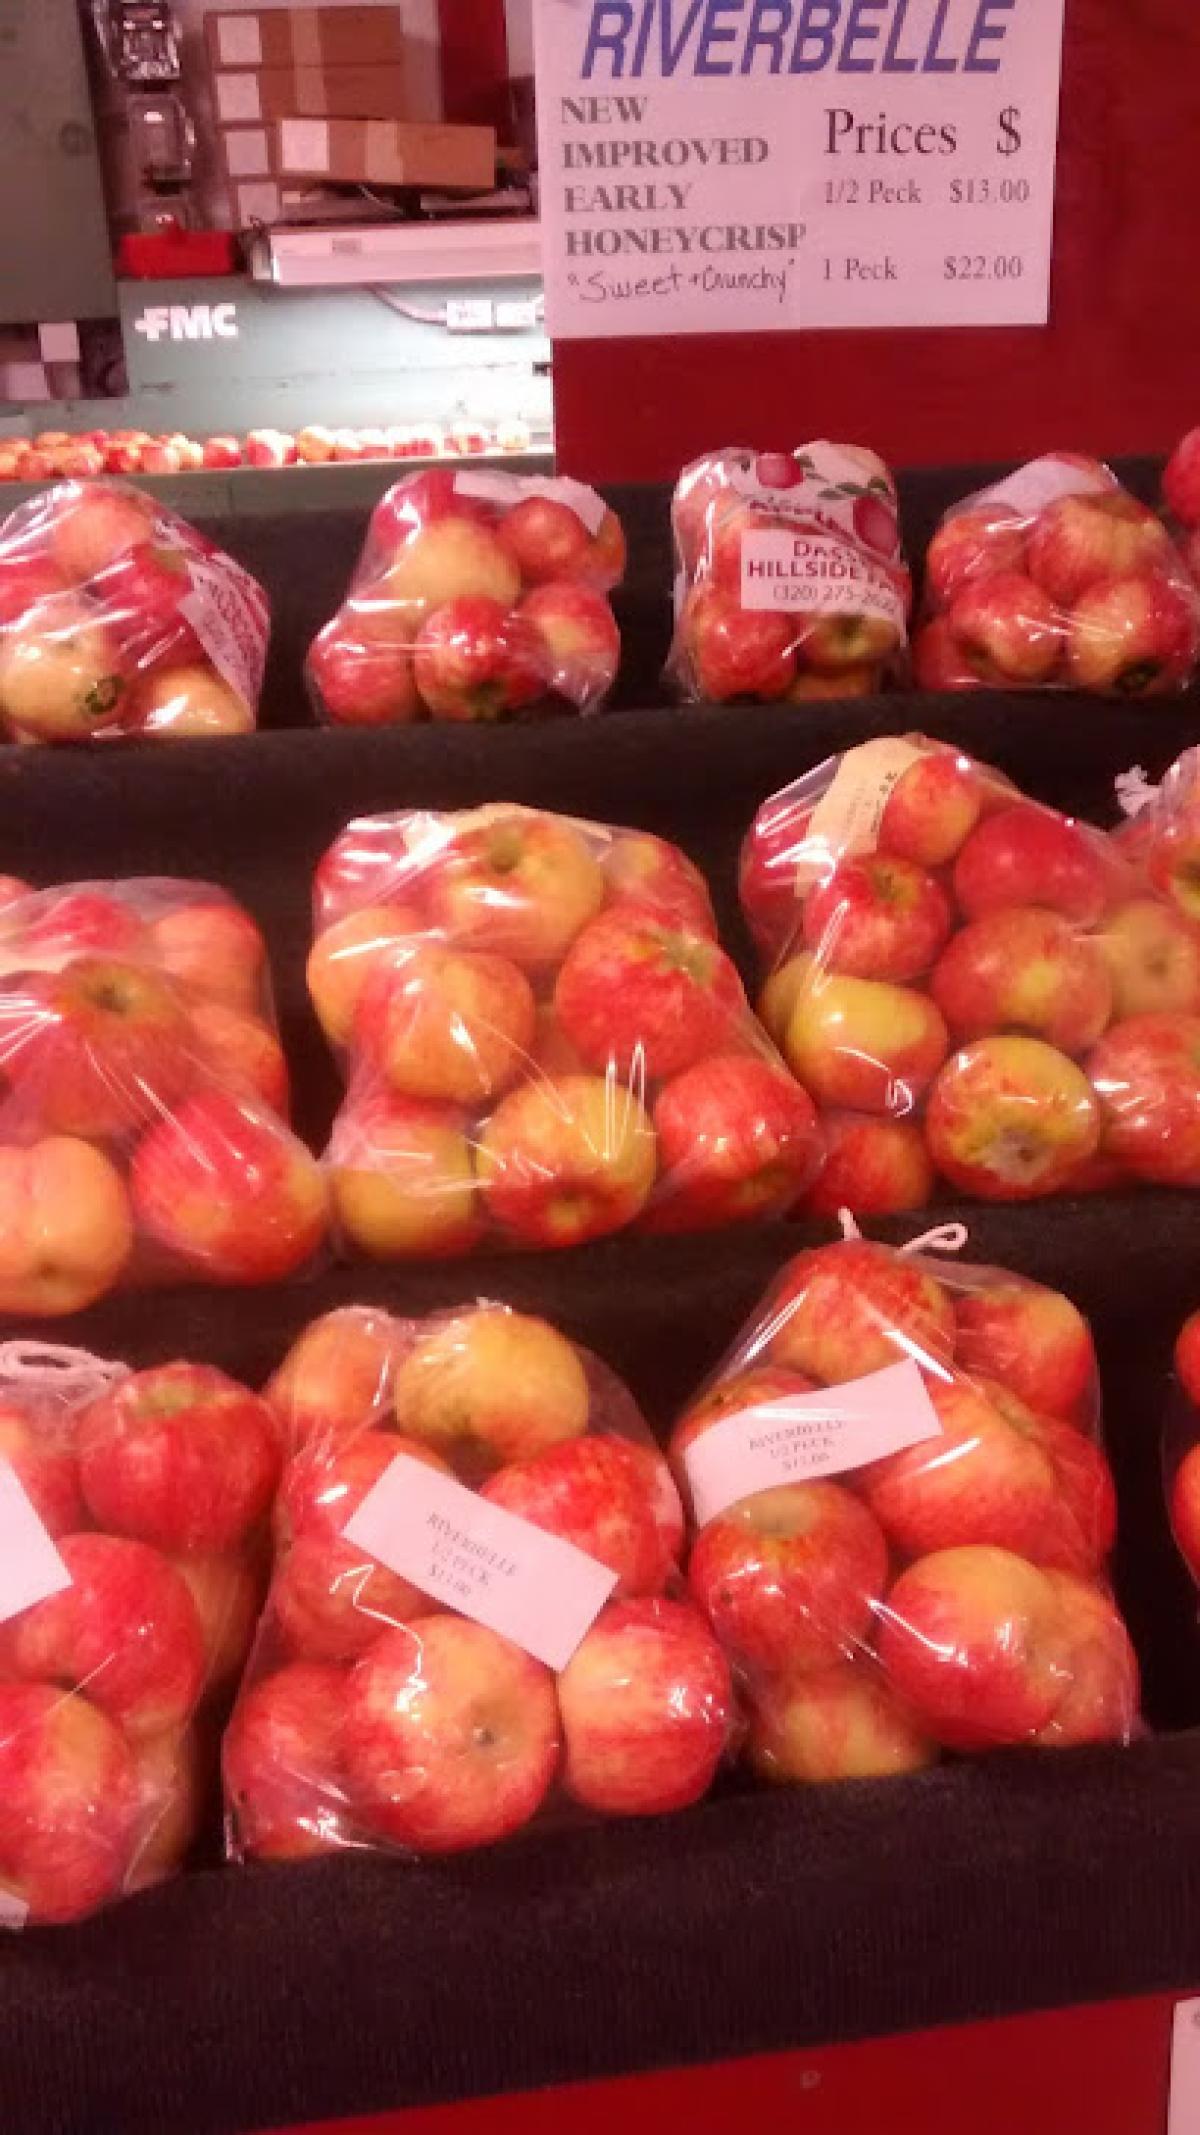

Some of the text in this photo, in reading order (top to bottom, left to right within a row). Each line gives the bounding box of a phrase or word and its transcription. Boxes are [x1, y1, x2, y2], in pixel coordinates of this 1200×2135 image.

[581, 0, 1015, 79] RIVERBELLE
[561, 96, 647, 124] NEW
[824, 105, 1022, 156] Prices $
[562, 137, 769, 168] IMPROVED
[563, 182, 694, 212] EARLY
[824, 178, 1030, 204] 1/2 Peck $13.00
[565, 222, 807, 256] HONEYCRISP
[823, 255, 1024, 281] 1 Peck $22.00
[134, 302, 239, 341] FMC
